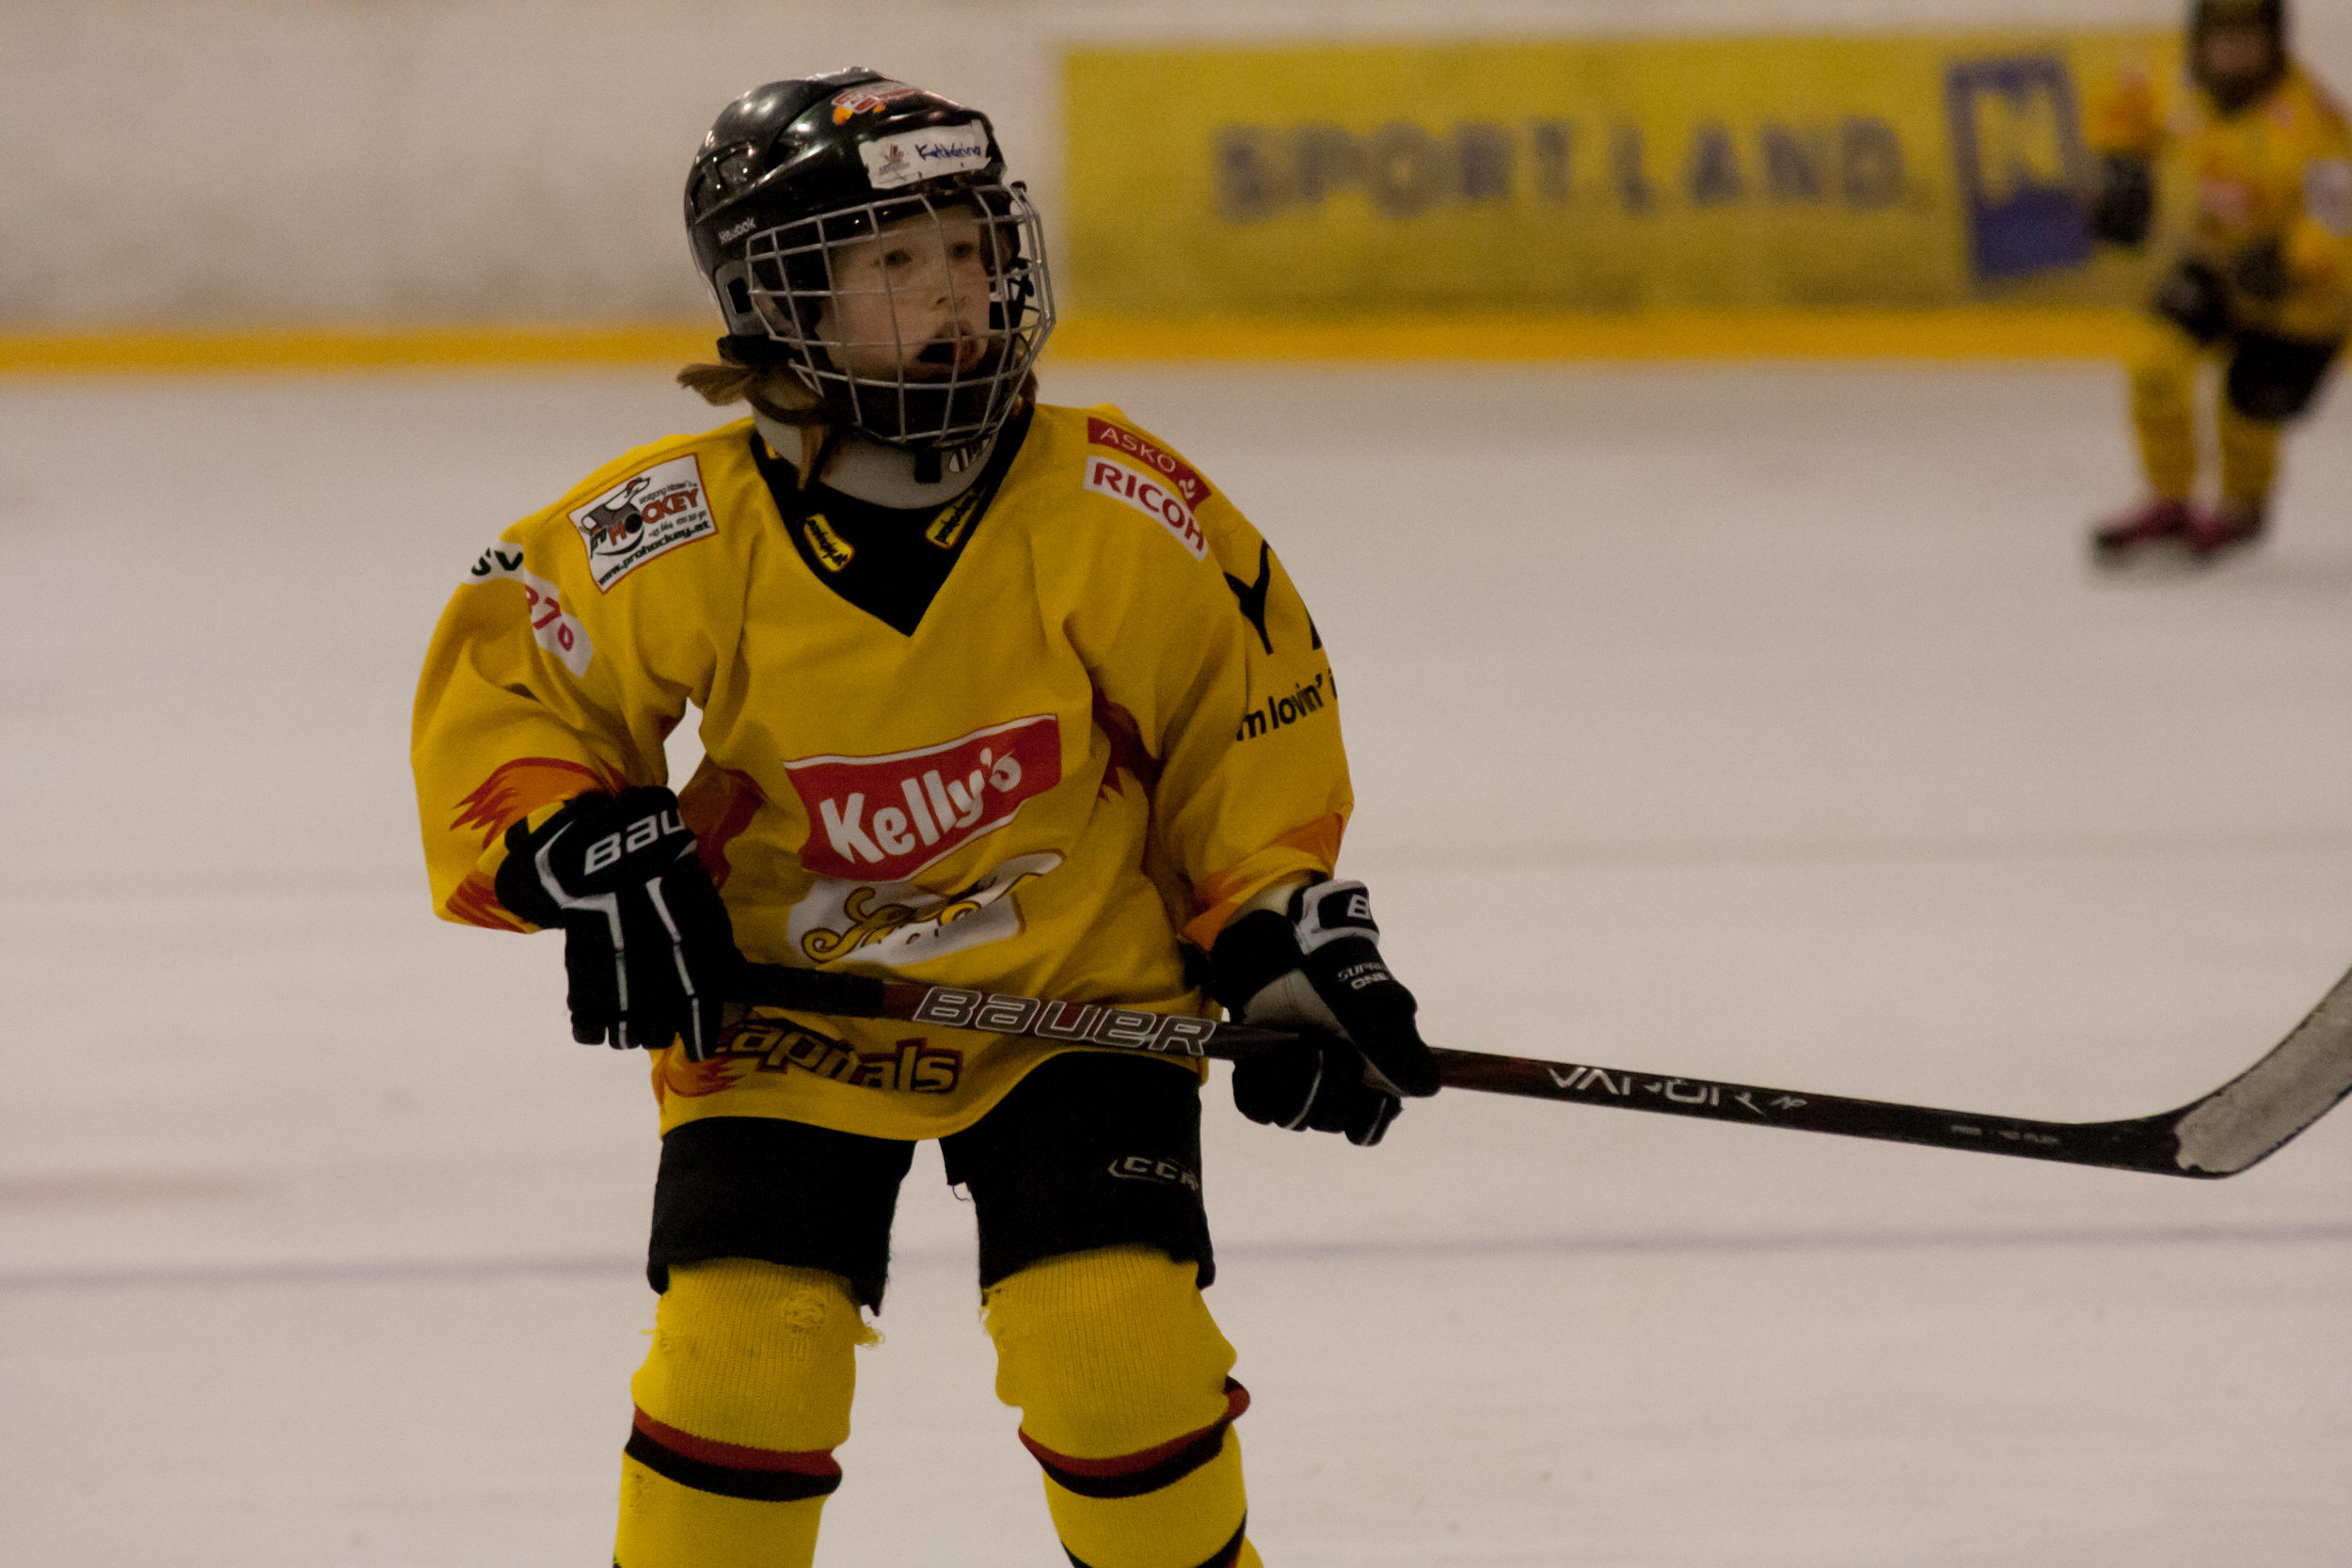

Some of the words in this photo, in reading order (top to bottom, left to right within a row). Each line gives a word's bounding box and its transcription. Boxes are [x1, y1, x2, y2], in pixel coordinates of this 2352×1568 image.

[1093, 462, 1204, 551] RICOH
[819, 747, 1023, 863] Kelly's
[912, 985, 1217, 1056] BAUER
